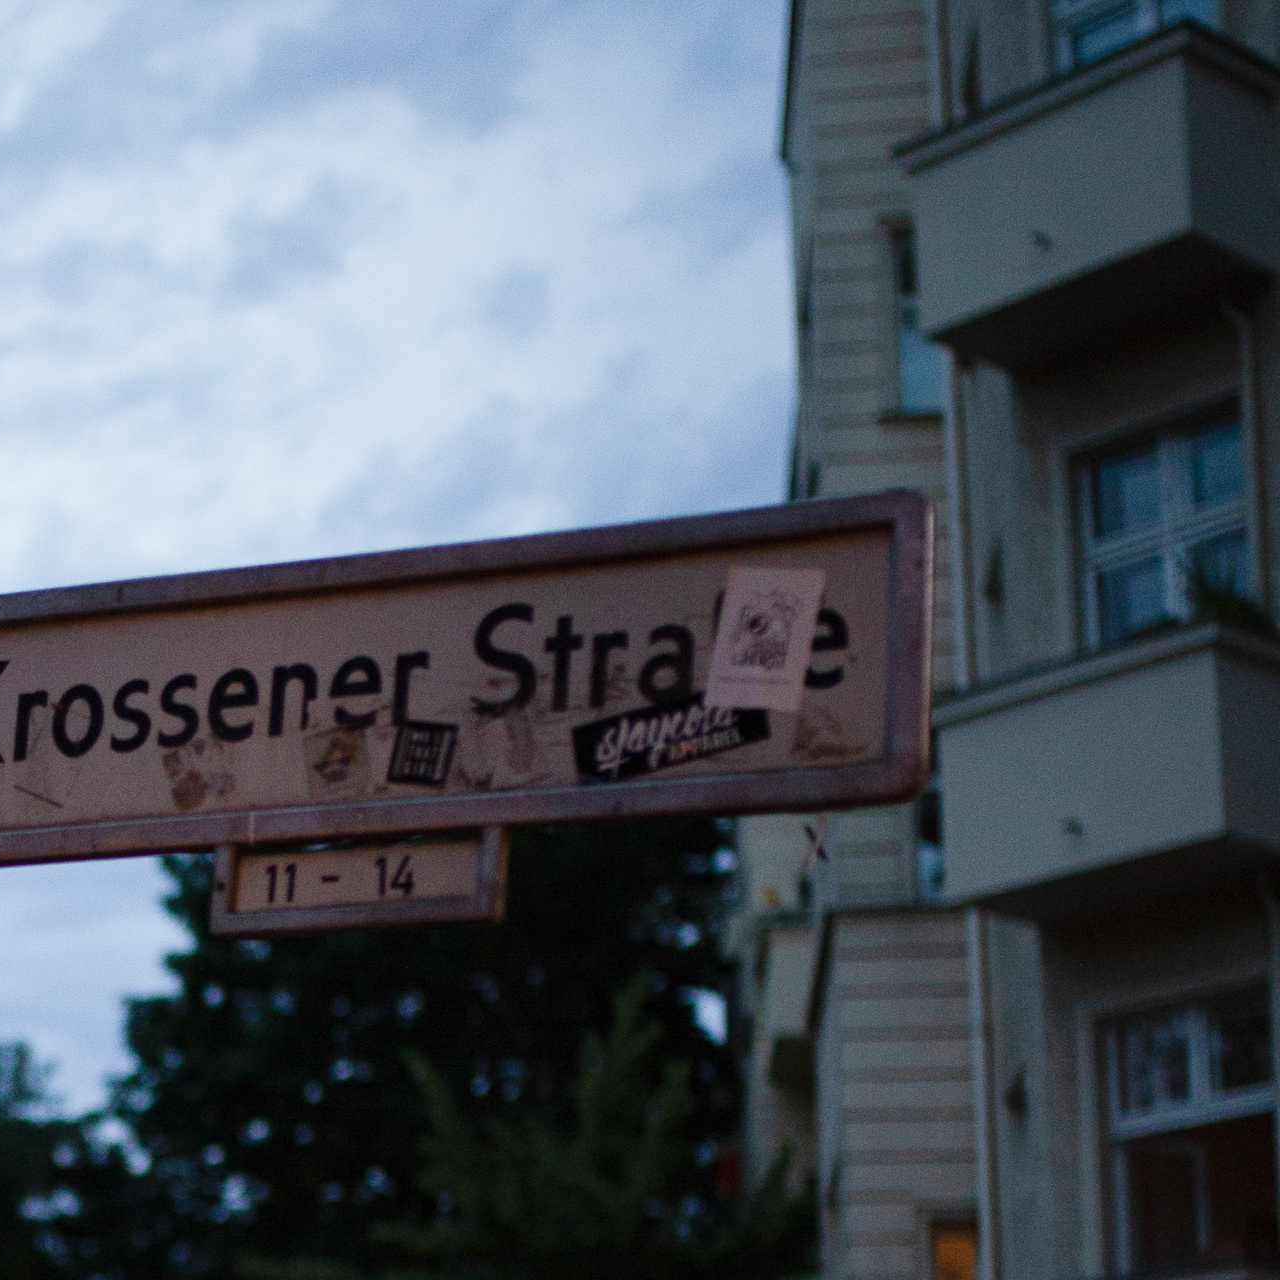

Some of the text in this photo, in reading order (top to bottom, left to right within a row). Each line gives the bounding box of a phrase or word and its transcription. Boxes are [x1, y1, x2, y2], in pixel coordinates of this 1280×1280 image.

[472, 588, 850, 714] Strae
[266, 863, 297, 903] 11
[375, 855, 415, 898] 14
